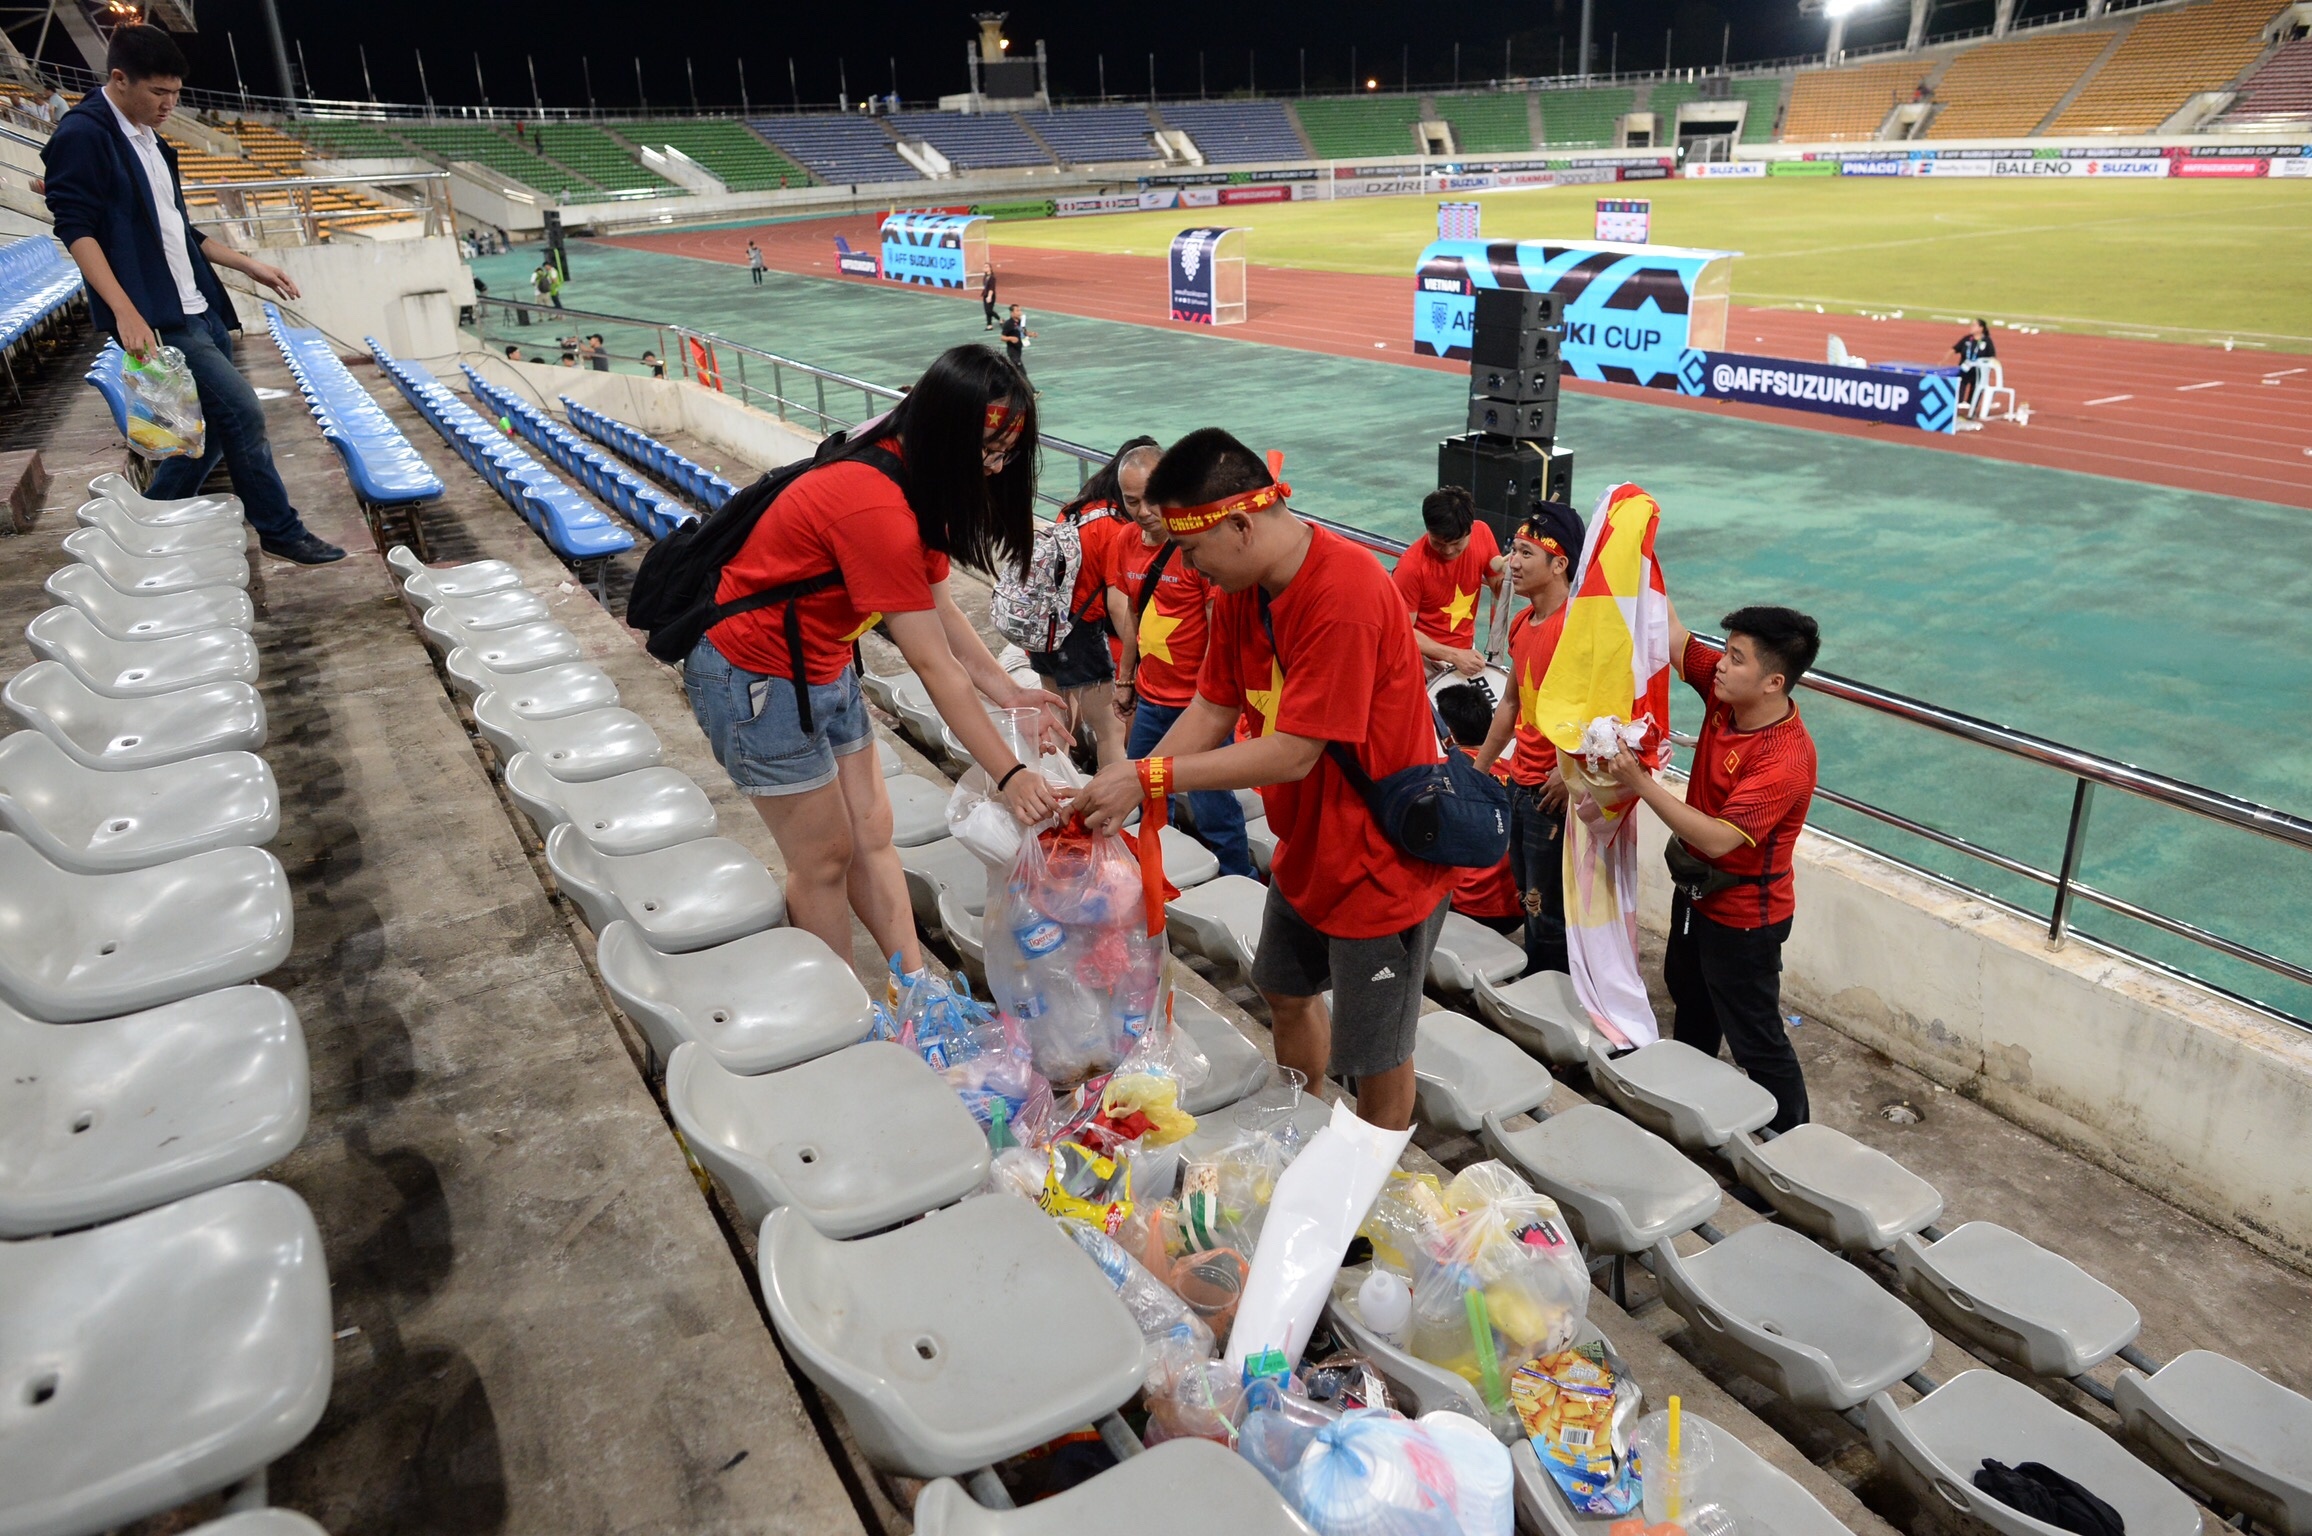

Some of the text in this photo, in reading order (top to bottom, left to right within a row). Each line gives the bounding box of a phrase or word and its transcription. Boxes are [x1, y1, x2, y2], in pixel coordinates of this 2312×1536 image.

[1709, 166, 1757, 175] SUZUKI
[1841, 160, 1898, 175] PINACO
[1995, 161, 2072, 174] BALENO
[2102, 163, 2158, 173] SUZUKI
[1450, 178, 1489, 188] SUZUKI
[1515, 174, 1554, 184] YANMAR
[1366, 179, 1428, 193] DZIRE
[895, 253, 956, 270] AFF SUZUKI CUP
[1424, 278, 1461, 293] VIETNAM
[1604, 325, 1662, 352] CUP
[1713, 364, 1910, 412] @AFFSUZUKICUP
[1371, 972, 1396, 982] adidas
